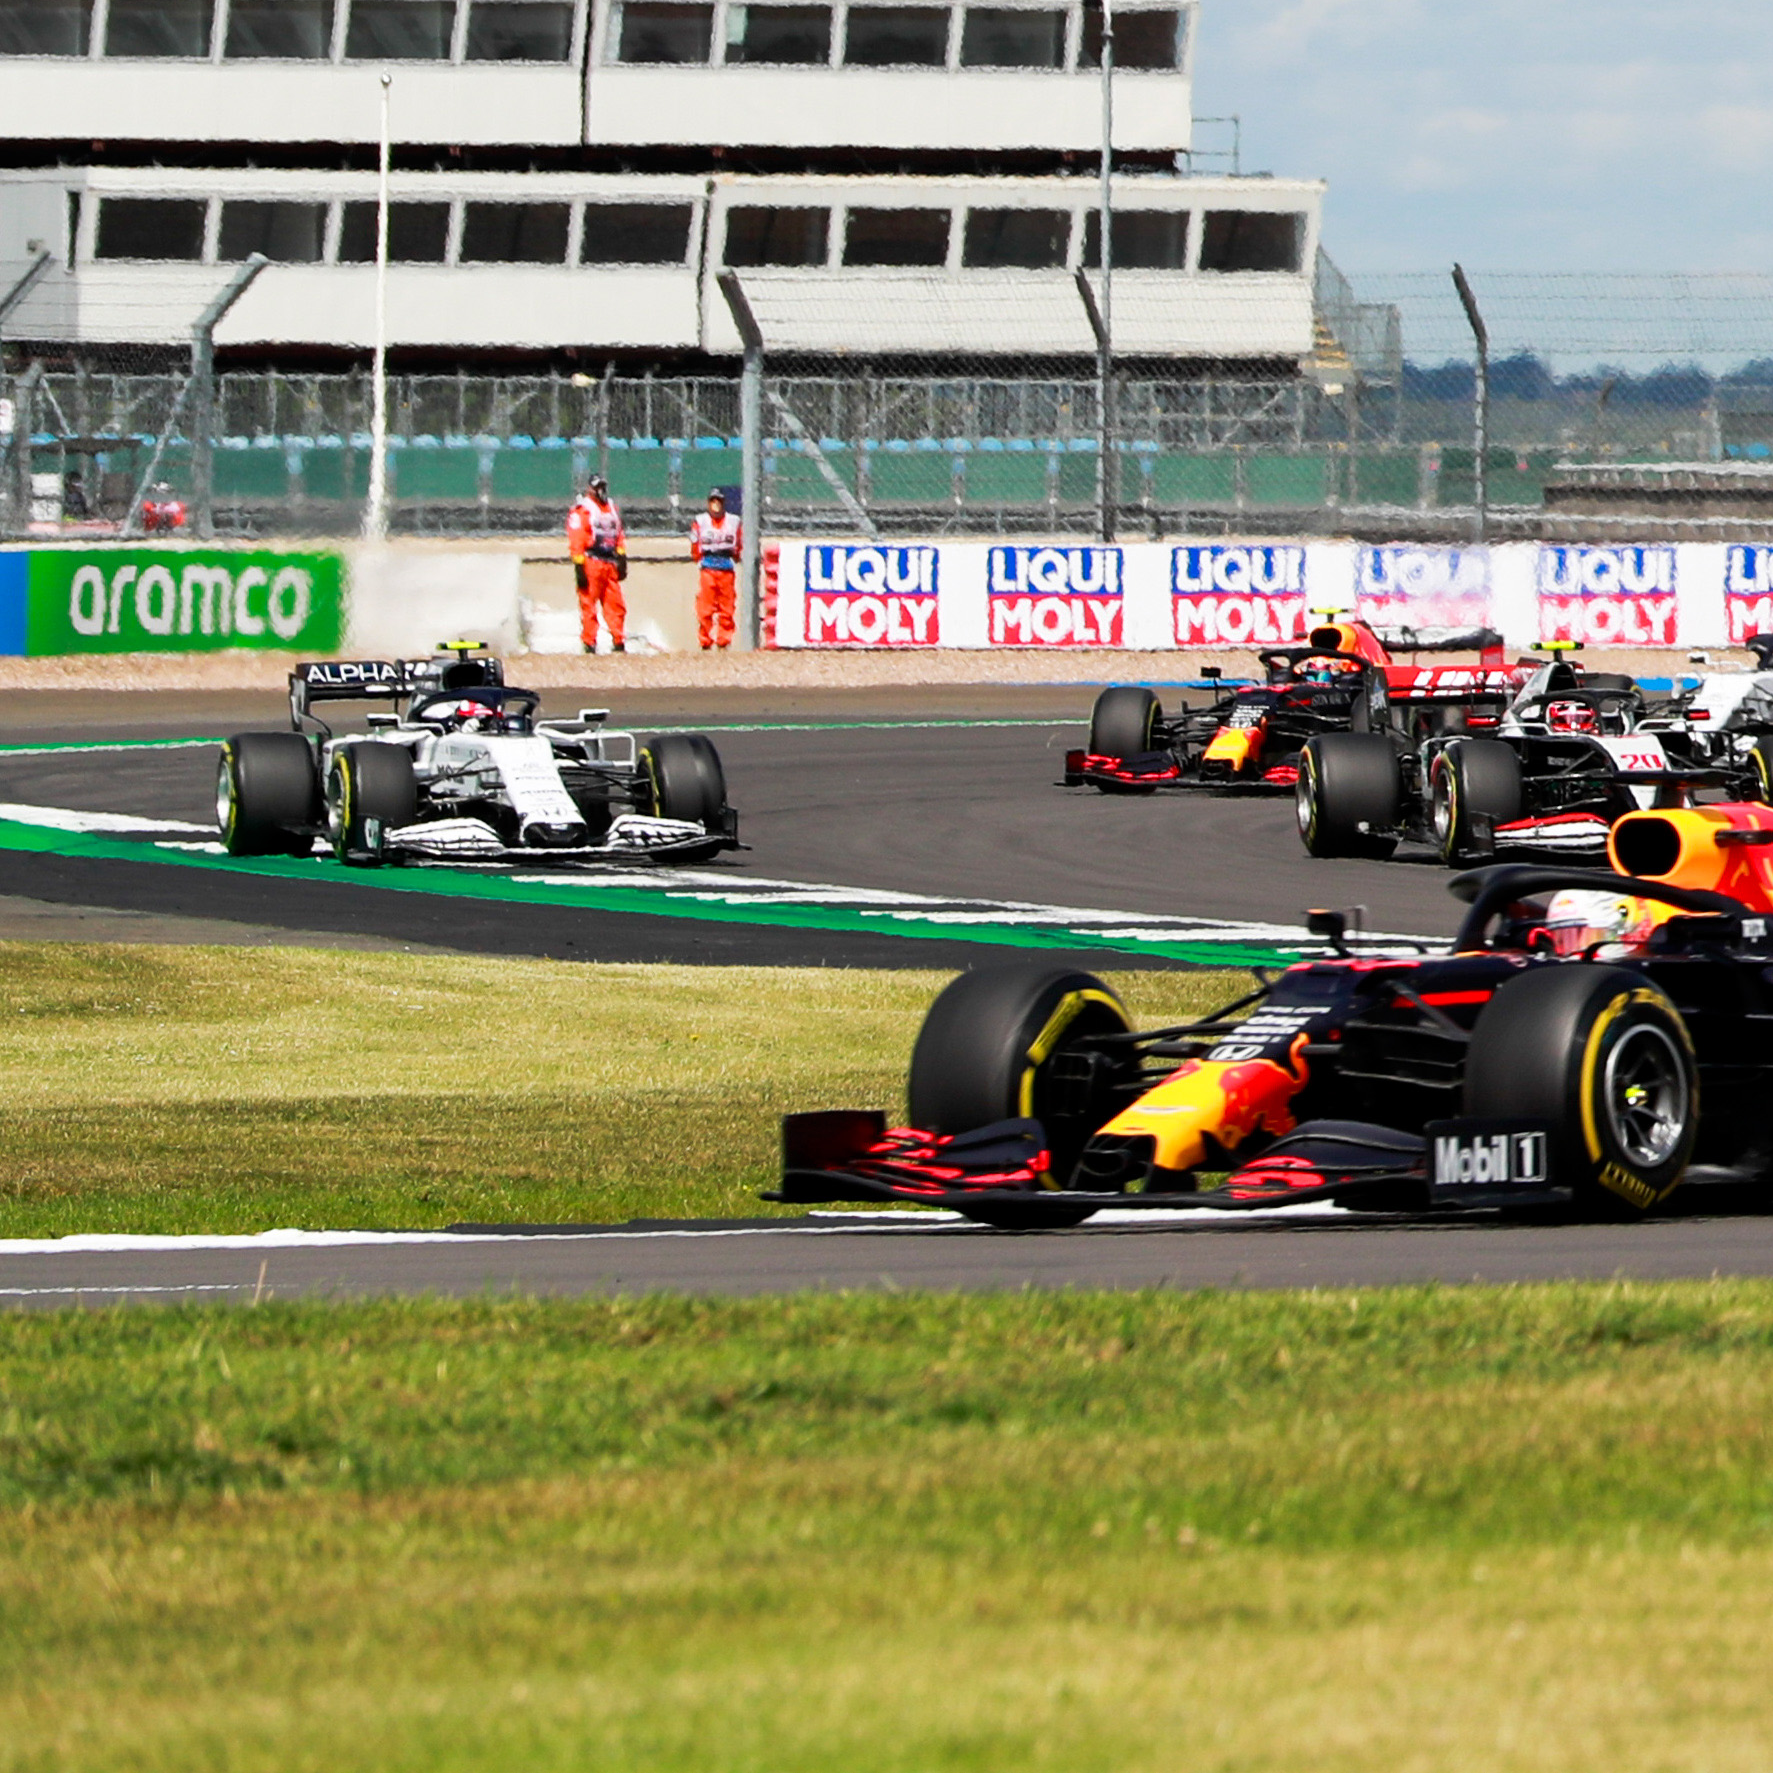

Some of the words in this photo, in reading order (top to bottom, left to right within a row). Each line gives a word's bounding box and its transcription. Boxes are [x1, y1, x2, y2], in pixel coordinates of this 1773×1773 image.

[809, 547, 934, 593] LIQUI
[992, 547, 1118, 594] LIQUI
[1177, 545, 1303, 594] LIQUI
[1544, 547, 1672, 594] LIQUI
[70, 564, 311, 640] aramco
[809, 597, 937, 643] MOLY
[993, 597, 1121, 644] MOLY
[1176, 597, 1309, 643] MOLY
[1541, 597, 1674, 644] MOLY
[1621, 754, 1665, 770] 20
[1435, 1134, 1508, 1185] Mobil
[1519, 1137, 1534, 1178] 1
